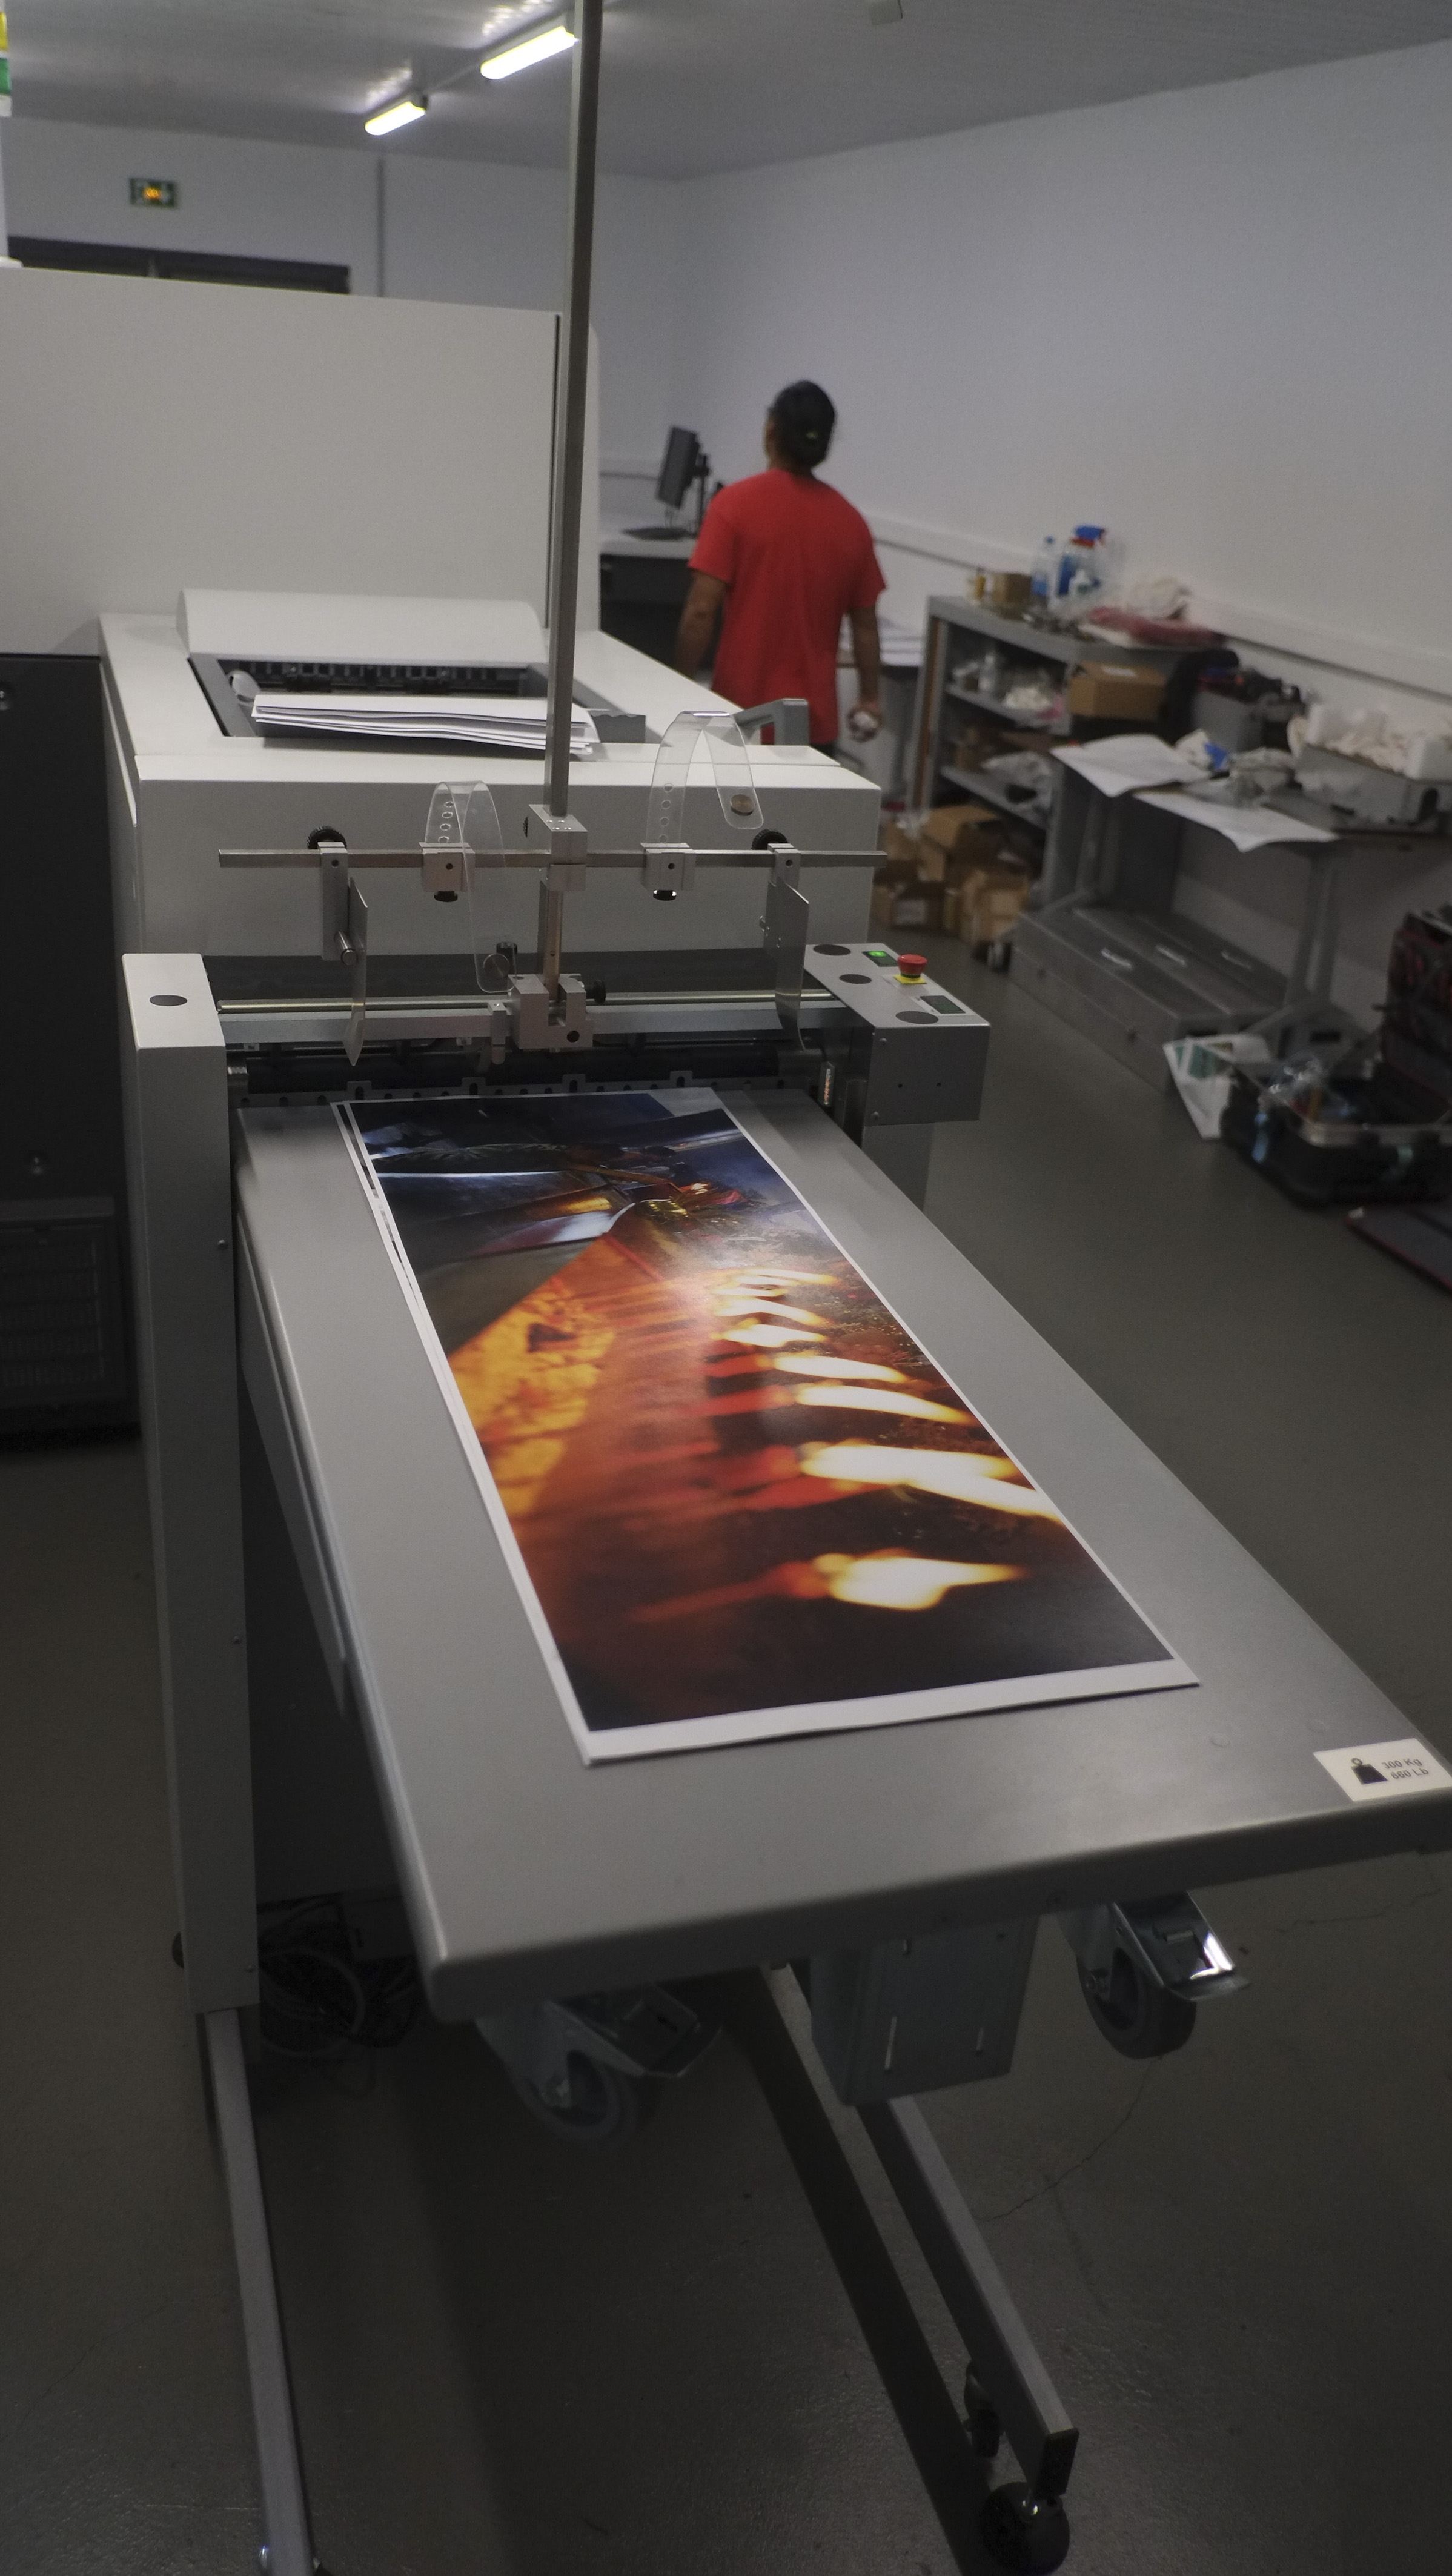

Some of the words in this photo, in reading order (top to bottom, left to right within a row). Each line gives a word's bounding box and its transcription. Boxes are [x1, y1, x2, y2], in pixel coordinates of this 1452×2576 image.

[1381, 1760, 1402, 1769] 300
[1404, 1758, 1422, 1767] Kg
[1390, 1770, 1411, 1779] 660
